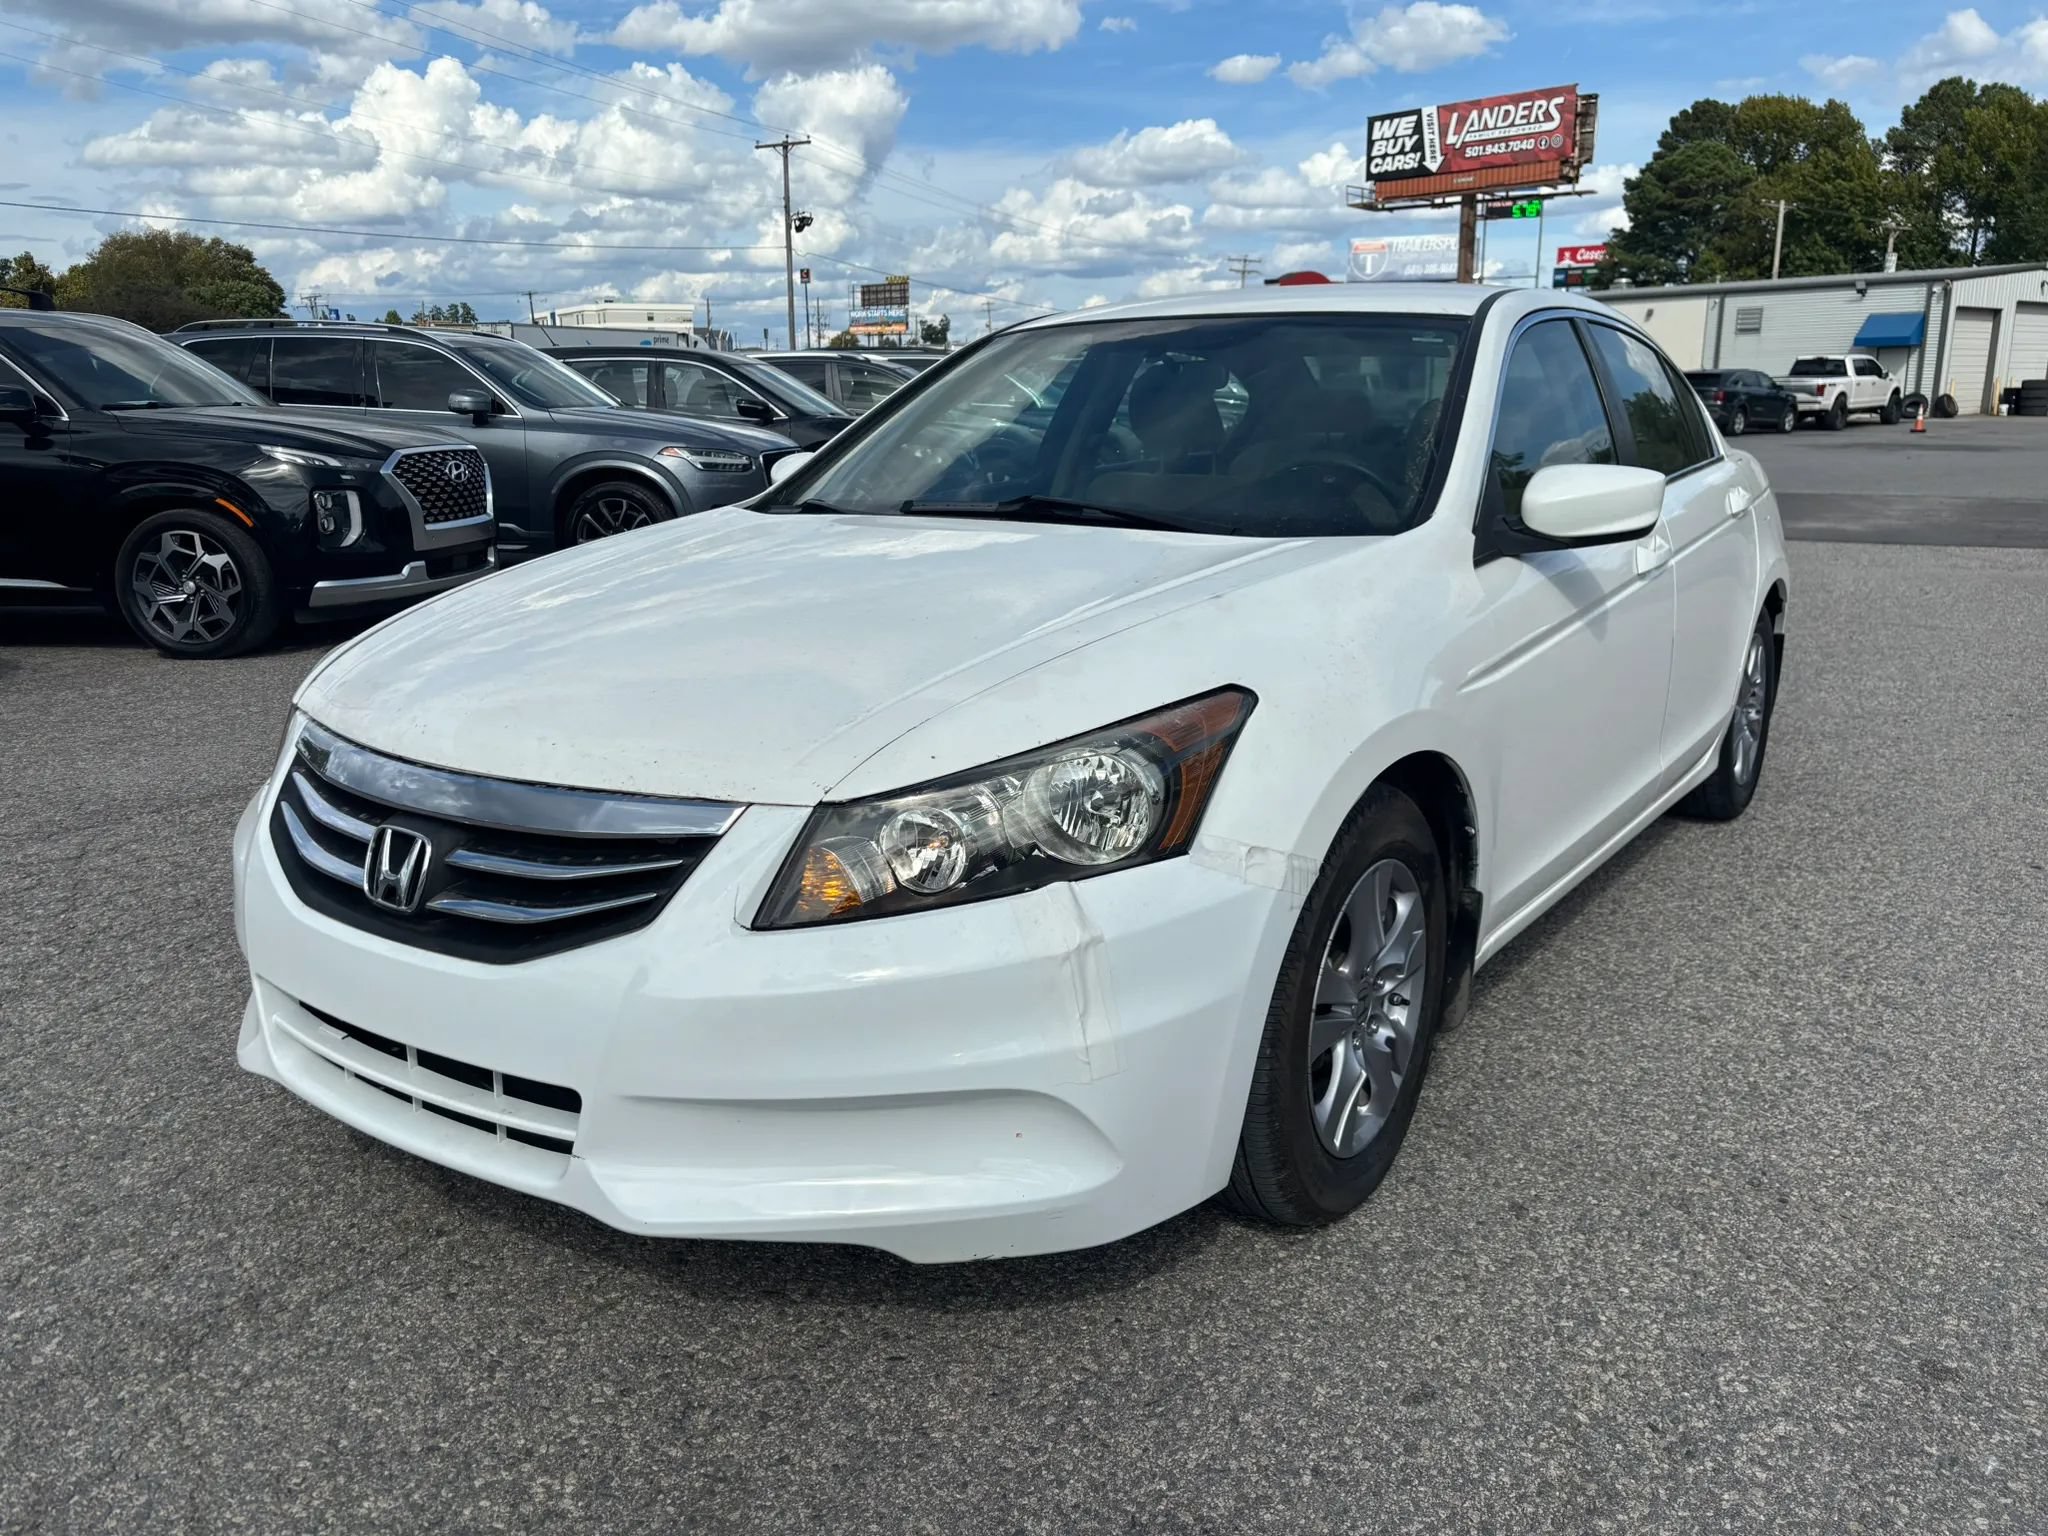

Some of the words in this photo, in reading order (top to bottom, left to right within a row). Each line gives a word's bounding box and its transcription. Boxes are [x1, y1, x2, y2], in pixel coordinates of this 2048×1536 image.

[1371, 115, 1418, 140] WE
[1426, 112, 1435, 135] VISIT
[1445, 96, 1565, 149] LANDERS
[1371, 134, 1420, 157] BUY
[1429, 138, 1438, 163] HERE!
[1369, 152, 1422, 175] CARS!
[1359, 254, 1378, 274] T
[653, 335, 669, 346] prime
